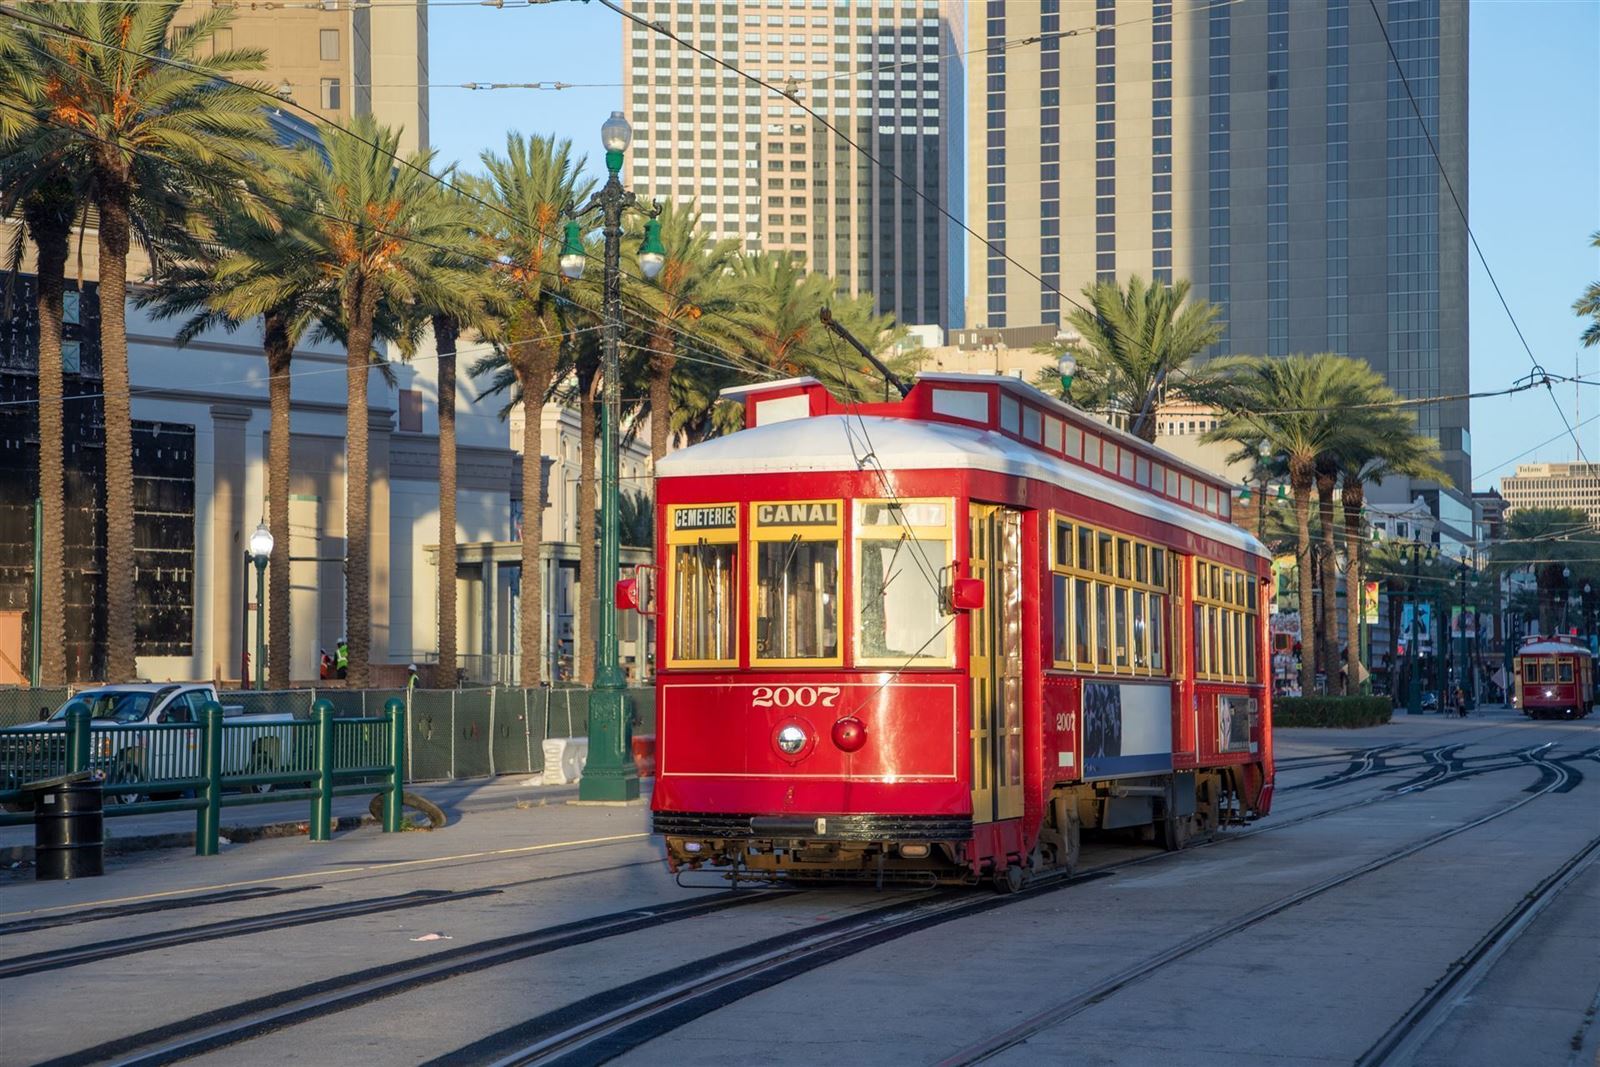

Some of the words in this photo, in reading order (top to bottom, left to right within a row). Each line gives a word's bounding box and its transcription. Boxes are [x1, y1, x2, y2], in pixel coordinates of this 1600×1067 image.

[675, 507, 736, 527] CEMETERIES
[759, 503, 837, 522] CANAL
[752, 686, 840, 707] 2007
[1056, 712, 1075, 731] 2007
